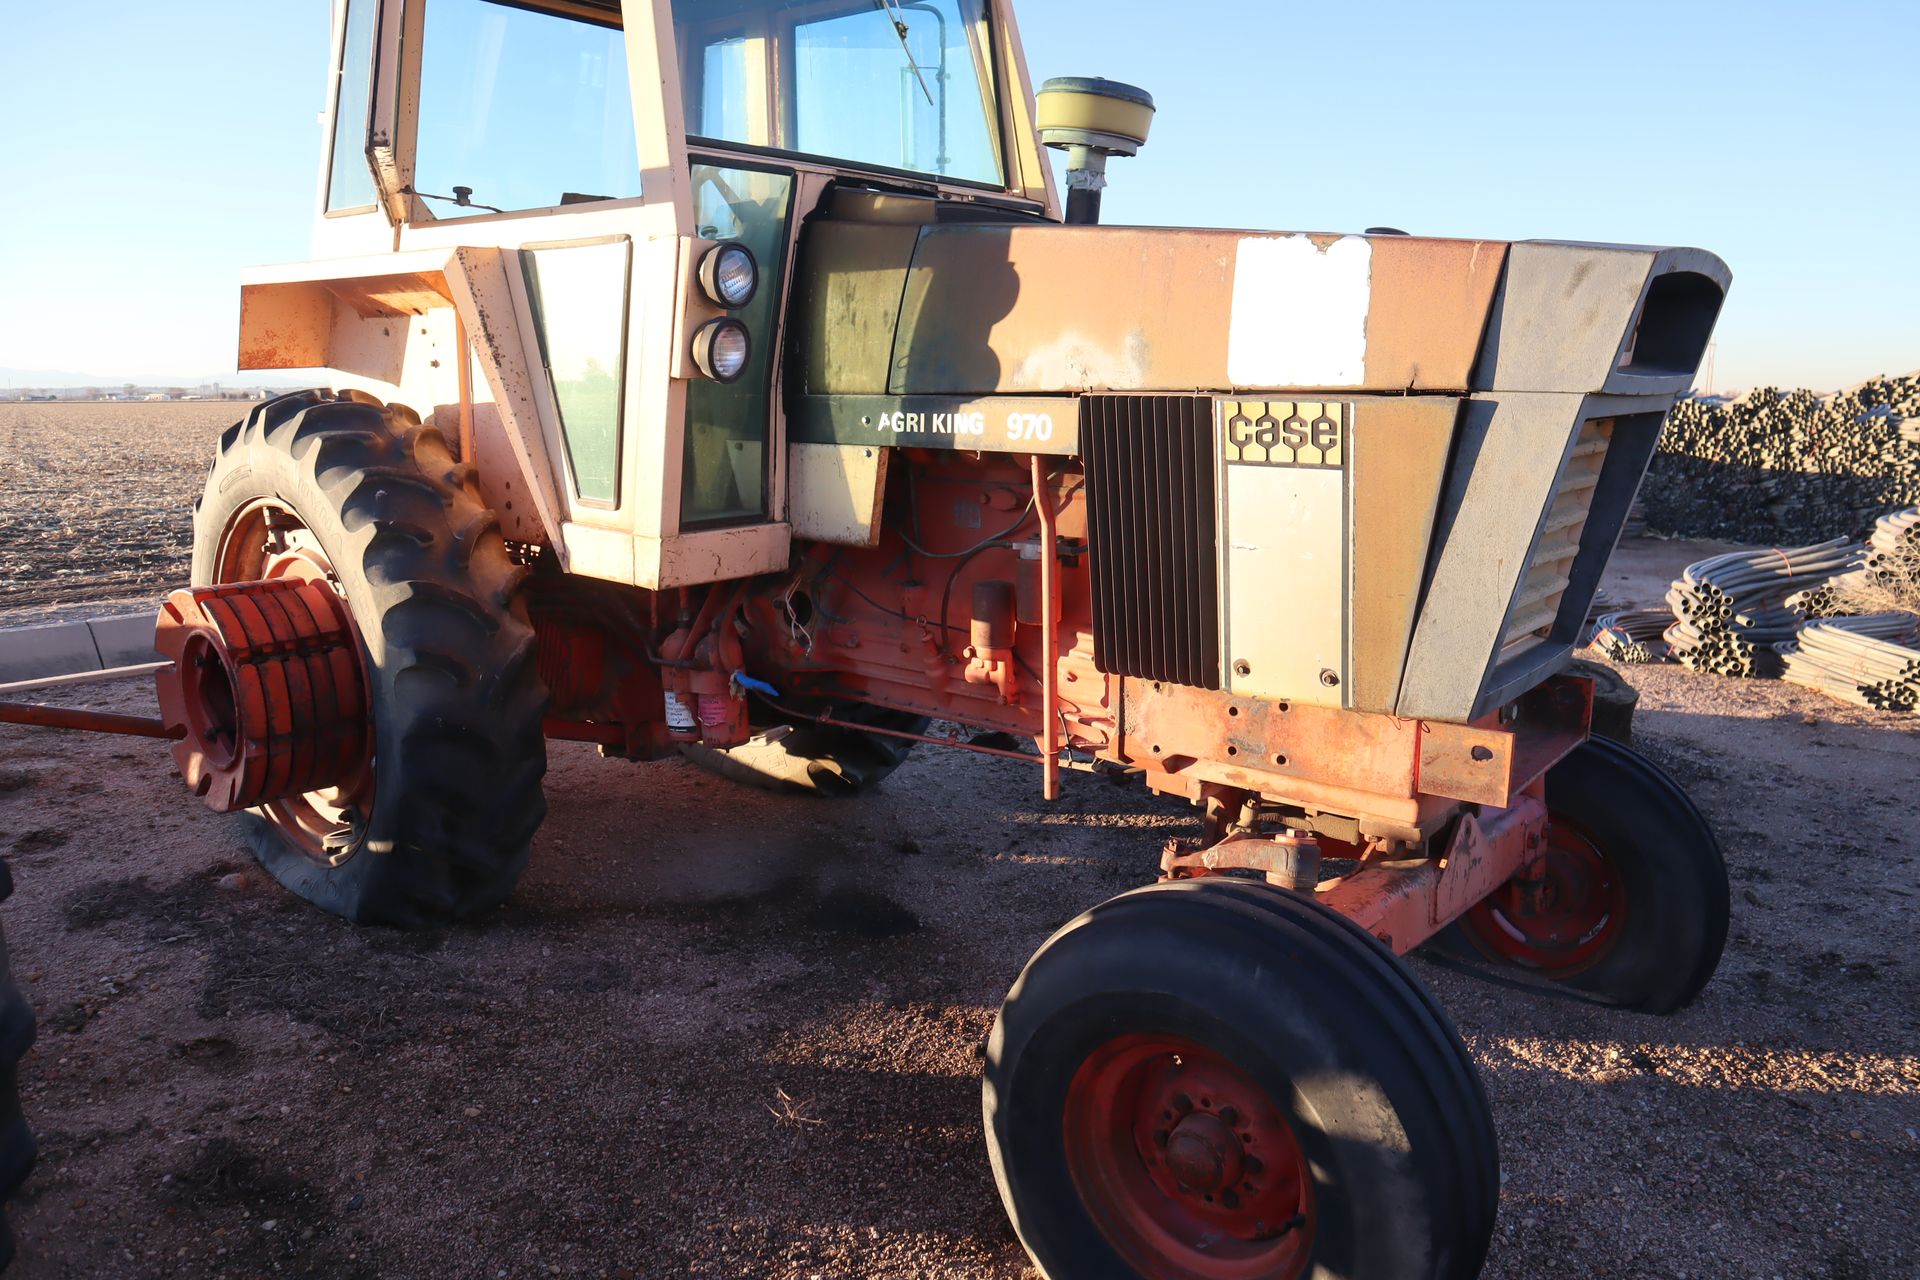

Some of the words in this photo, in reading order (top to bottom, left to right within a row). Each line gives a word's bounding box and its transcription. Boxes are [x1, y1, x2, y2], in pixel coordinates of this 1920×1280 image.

[878, 411, 925, 433] AGRI
[932, 412, 985, 435] KING
[1006, 412, 1053, 442] 970
